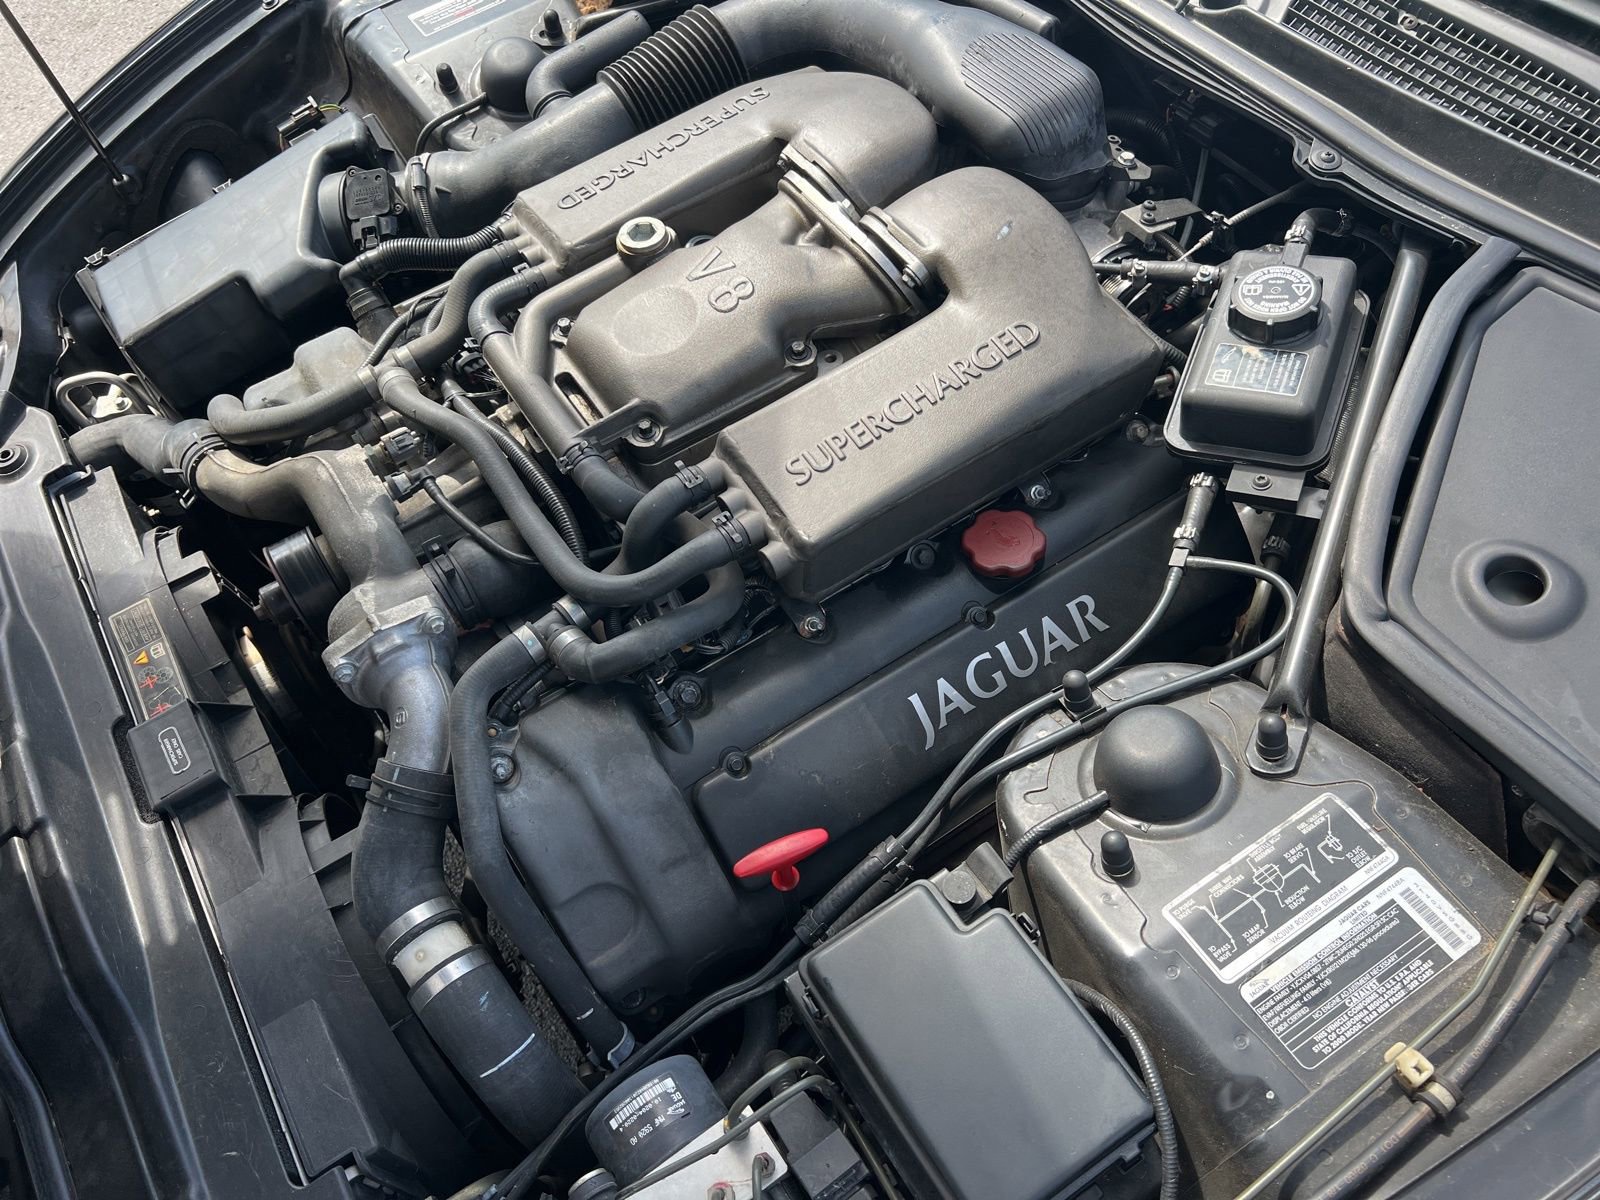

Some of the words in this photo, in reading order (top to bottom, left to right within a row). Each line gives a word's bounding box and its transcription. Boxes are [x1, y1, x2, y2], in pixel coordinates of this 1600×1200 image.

[557, 86, 771, 210] SUPERCHARGED
[686, 246, 755, 314] V8
[1287, 301, 1300, 310] NOT
[785, 321, 1041, 487] SUPERCHARGED
[907, 594, 1110, 751] JAGUAR
[1286, 850, 1304, 864] SERVO
[1287, 841, 1305, 856] BRAKE
[1282, 883, 1310, 906] INDUCTION
[1287, 894, 1307, 910] ELBOW
[1269, 923, 1296, 945] VACUUM
[1320, 884, 1349, 907] DIAGRAM
[1336, 908, 1358, 925] JAGUAR
[1354, 898, 1372, 912] CARS
[1348, 909, 1369, 925] LIMITED
[1245, 927, 1266, 945] SENSOR
[1247, 922, 1262, 935] MAP
[1211, 942, 1231, 958] BYPASS
[1216, 949, 1233, 964] VALVE
[1269, 973, 1294, 993] VEHICLE
[1290, 955, 1319, 977] EMISSION
[1315, 937, 1344, 959] CONTROL
[1340, 911, 1378, 941] INFORMATION
[1297, 977, 1318, 994] FAMILY
[1310, 1008, 1324, 1020] NO
[1319, 994, 1343, 1014] ENGINE
[1338, 972, 1373, 1000] ADJUSTMENT
[1368, 951, 1400, 977] NECESSARY
[1343, 978, 1381, 1009] CATALYST
[1255, 997, 1276, 1015] ENGINE
[1271, 986, 1291, 1002] FAMILY
[1266, 998, 1303, 1028] DISPLACEMENT
[1310, 1036, 1331, 1054] STATE
[1334, 1006, 1370, 1036] CALIFORNIA
[1399, 957, 1434, 986] APPLICABLE
[1312, 1029, 1329, 1043] THIS
[1324, 1012, 1350, 1035] VEHICLE
[1345, 990, 1380, 1018] CONFORMS
[1406, 957, 1423, 971] AND
[1328, 1033, 1347, 1050] 2000
[1361, 1008, 1379, 1025] YEAR
[1374, 999, 1392, 1014] NEW
[1415, 966, 1435, 982] CARS
[1285, 1004, 1311, 1025] CERTIFIED
[669, 1089, 683, 1103] DE
